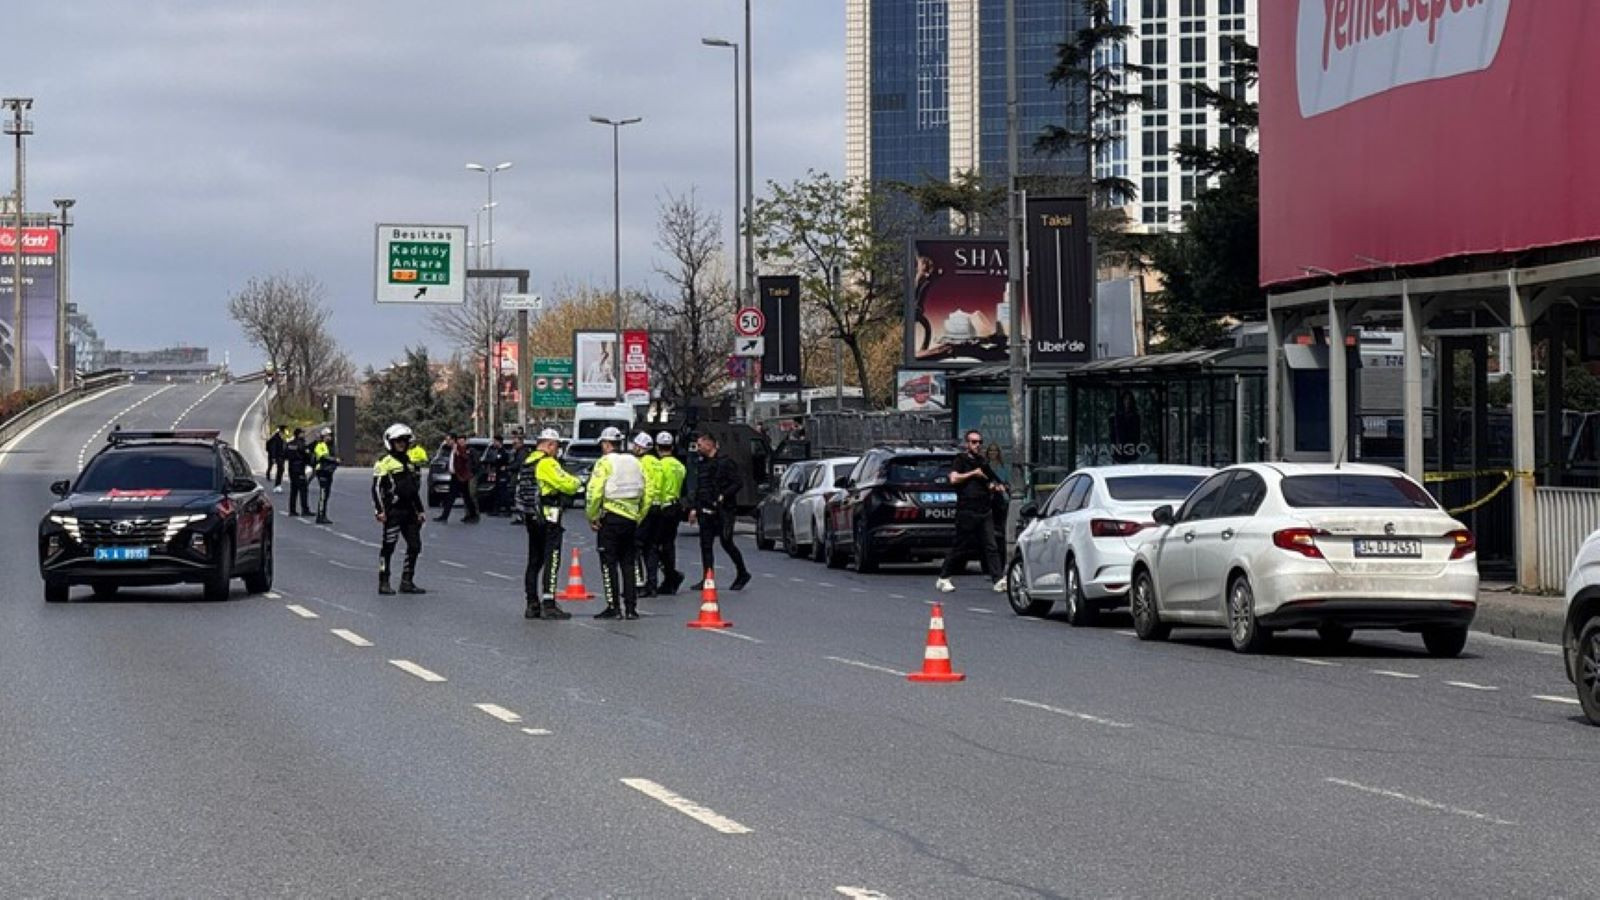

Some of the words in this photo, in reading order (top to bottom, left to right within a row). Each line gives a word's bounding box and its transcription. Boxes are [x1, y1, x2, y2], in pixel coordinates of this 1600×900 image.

[1040, 213, 1073, 227] Taksi
[392, 229, 453, 241] Beşiktaş
[391, 245, 448, 258] Kadıköy
[954, 248, 1003, 267] SHA
[1, 256, 53, 266] SASUNG
[392, 257, 443, 269] Ankara
[742, 315, 758, 328] 50
[1037, 339, 1086, 353] Uber'de
[1084, 442, 1150, 457] MANGO
